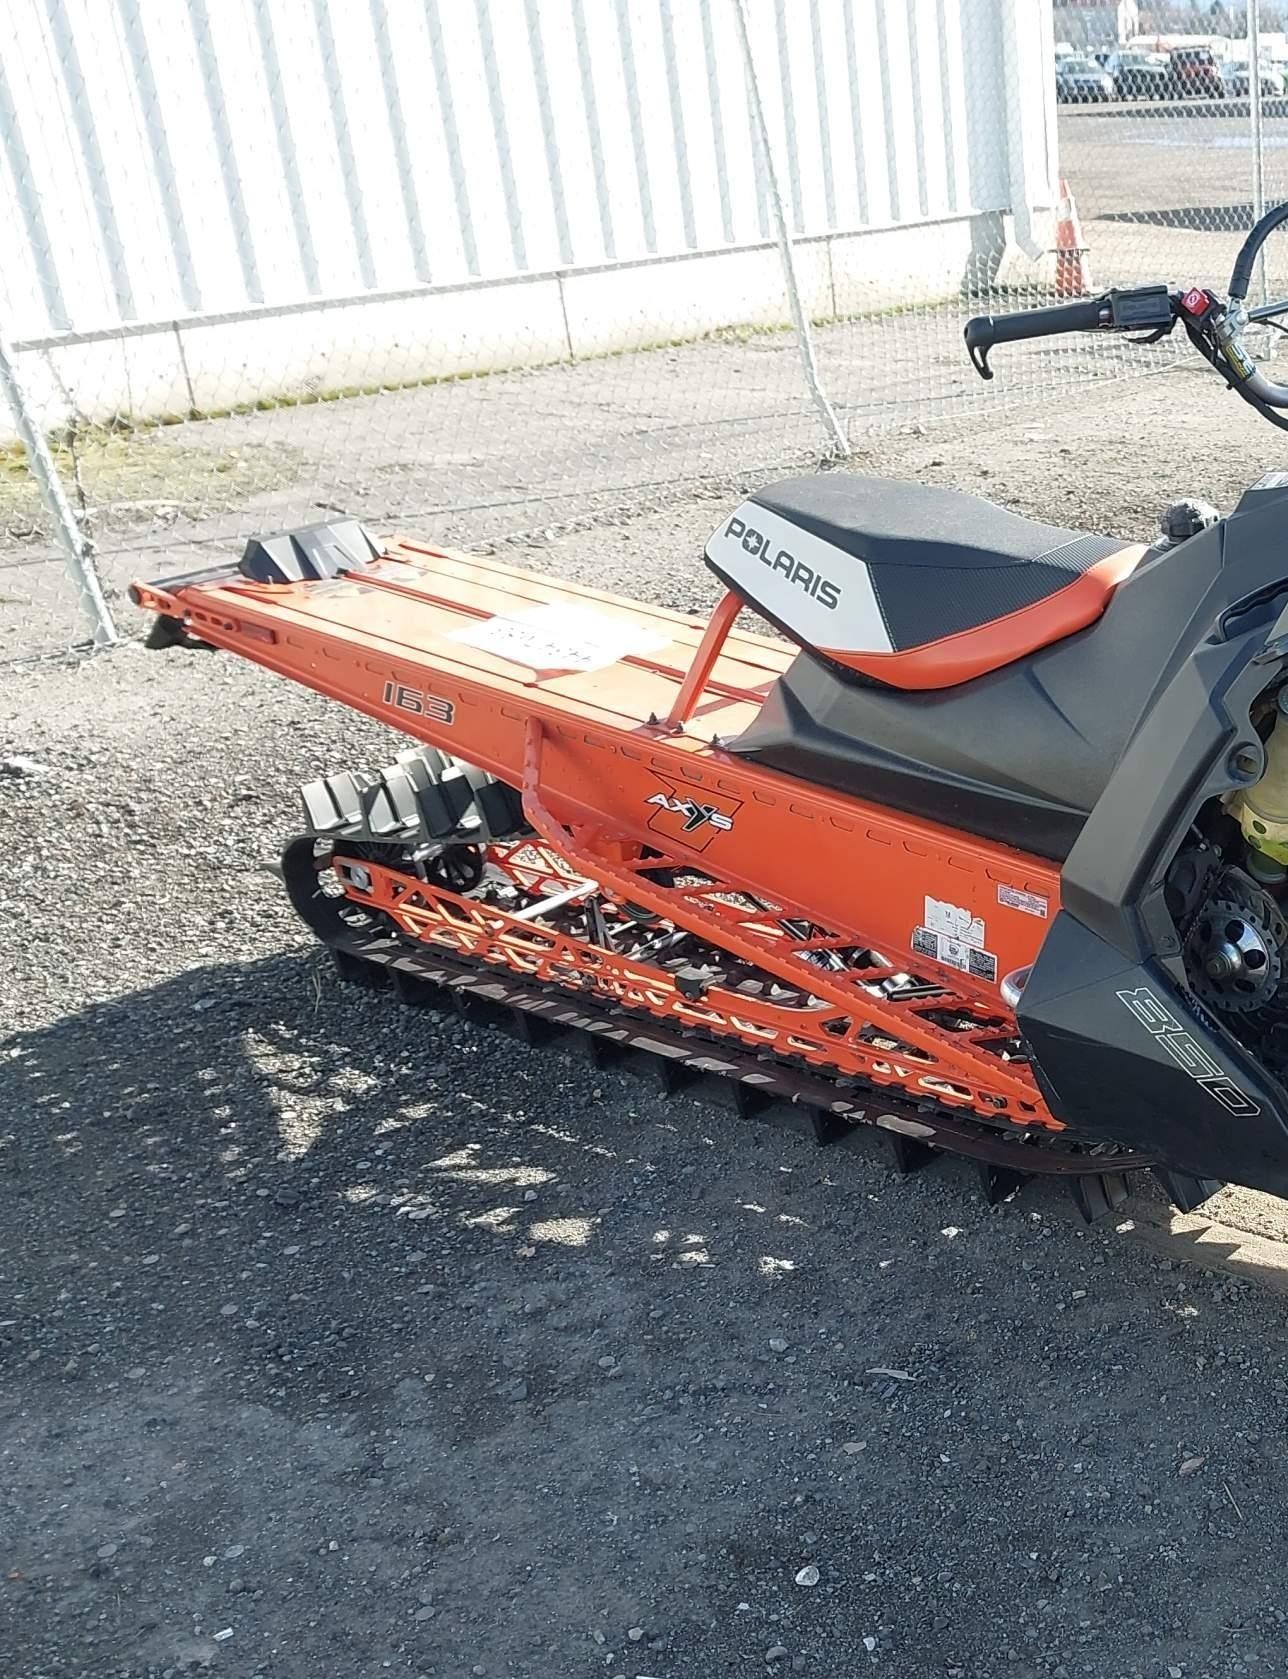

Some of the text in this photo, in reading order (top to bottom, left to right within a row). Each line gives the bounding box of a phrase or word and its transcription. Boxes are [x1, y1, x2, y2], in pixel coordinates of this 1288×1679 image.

[724, 516, 842, 610] POLARIS
[382, 680, 455, 726] 163
[644, 792, 734, 832] AXYS
[1115, 987, 1261, 1117] 850
